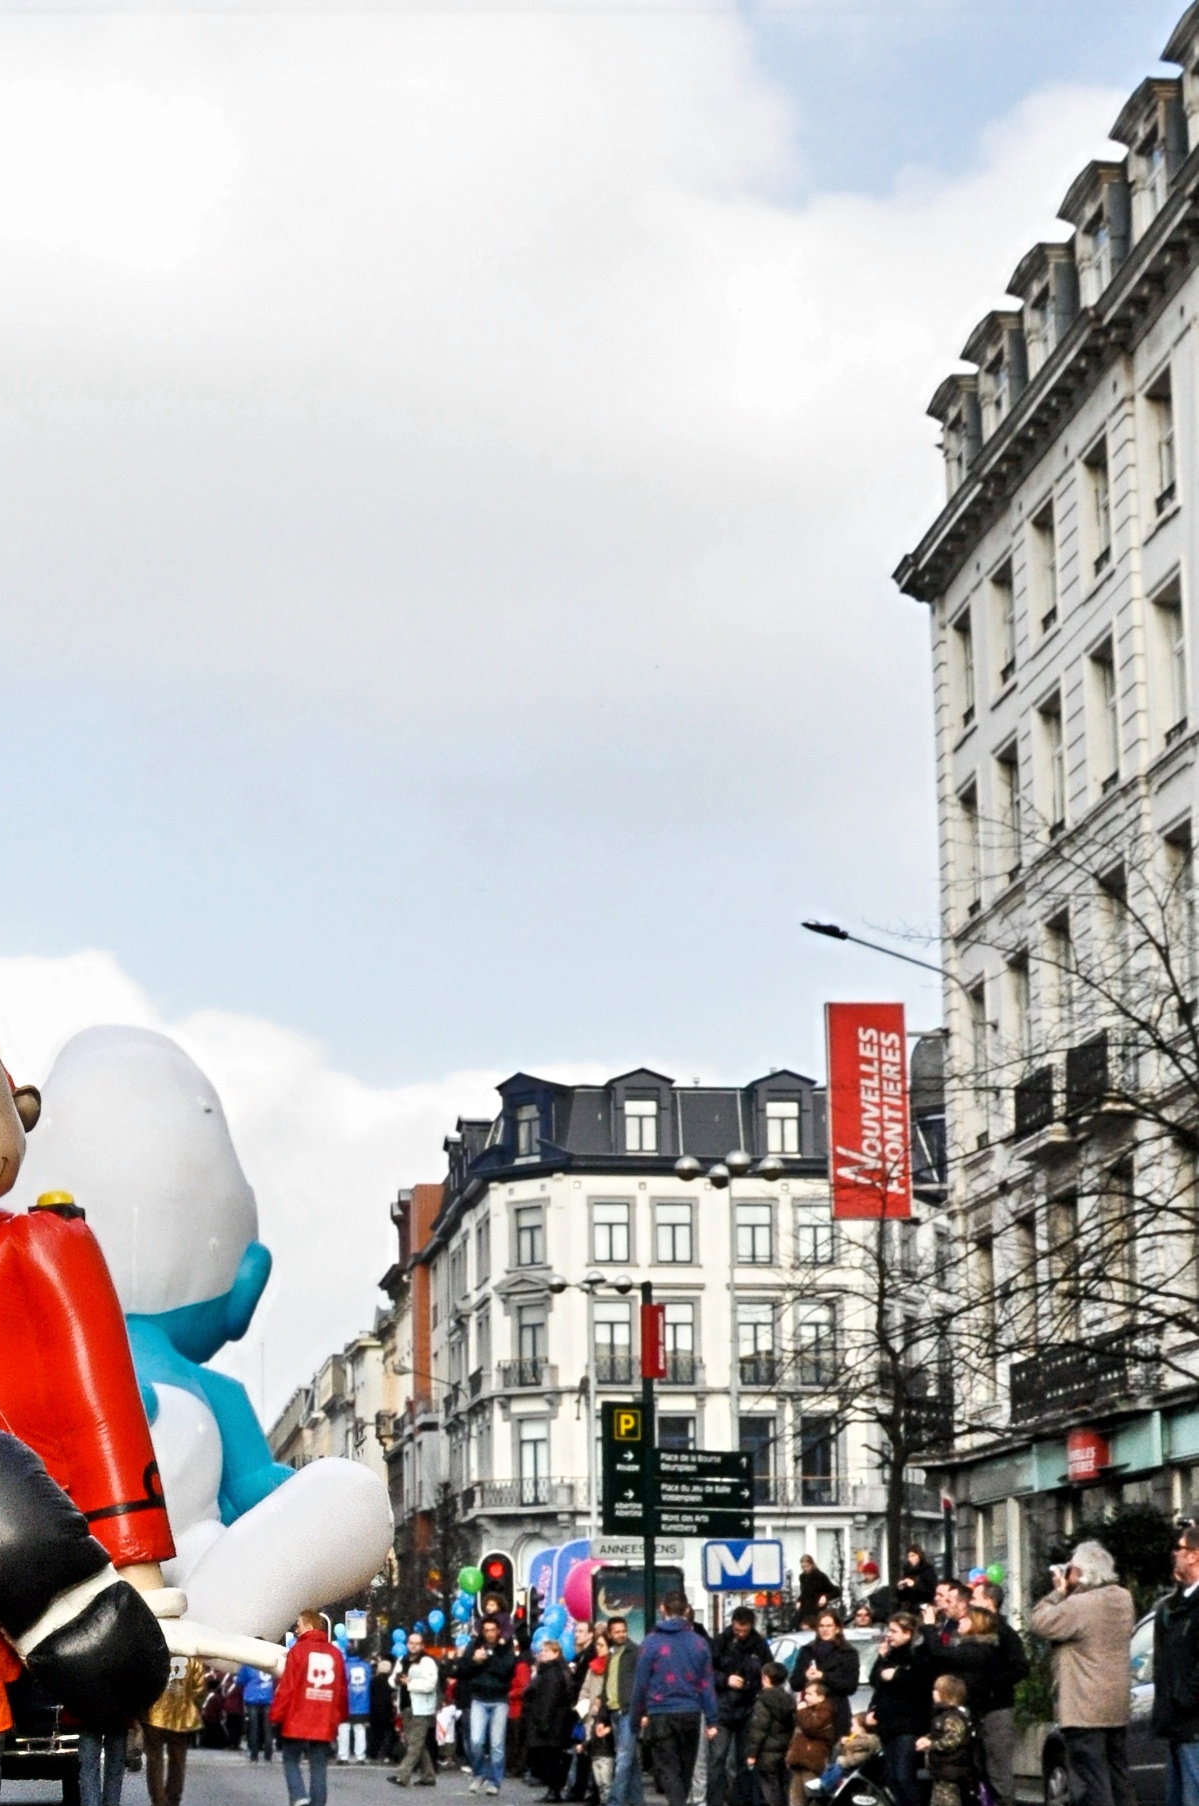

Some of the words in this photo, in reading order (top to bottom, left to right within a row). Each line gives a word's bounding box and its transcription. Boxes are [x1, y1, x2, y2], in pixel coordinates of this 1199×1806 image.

[836, 1027, 883, 1188] NOUVELLES
[619, 1414, 635, 1436] P
[660, 1453, 679, 1461] Place
[660, 1483, 680, 1492] Place
[600, 1544, 677, 1555] ANNEESENS
